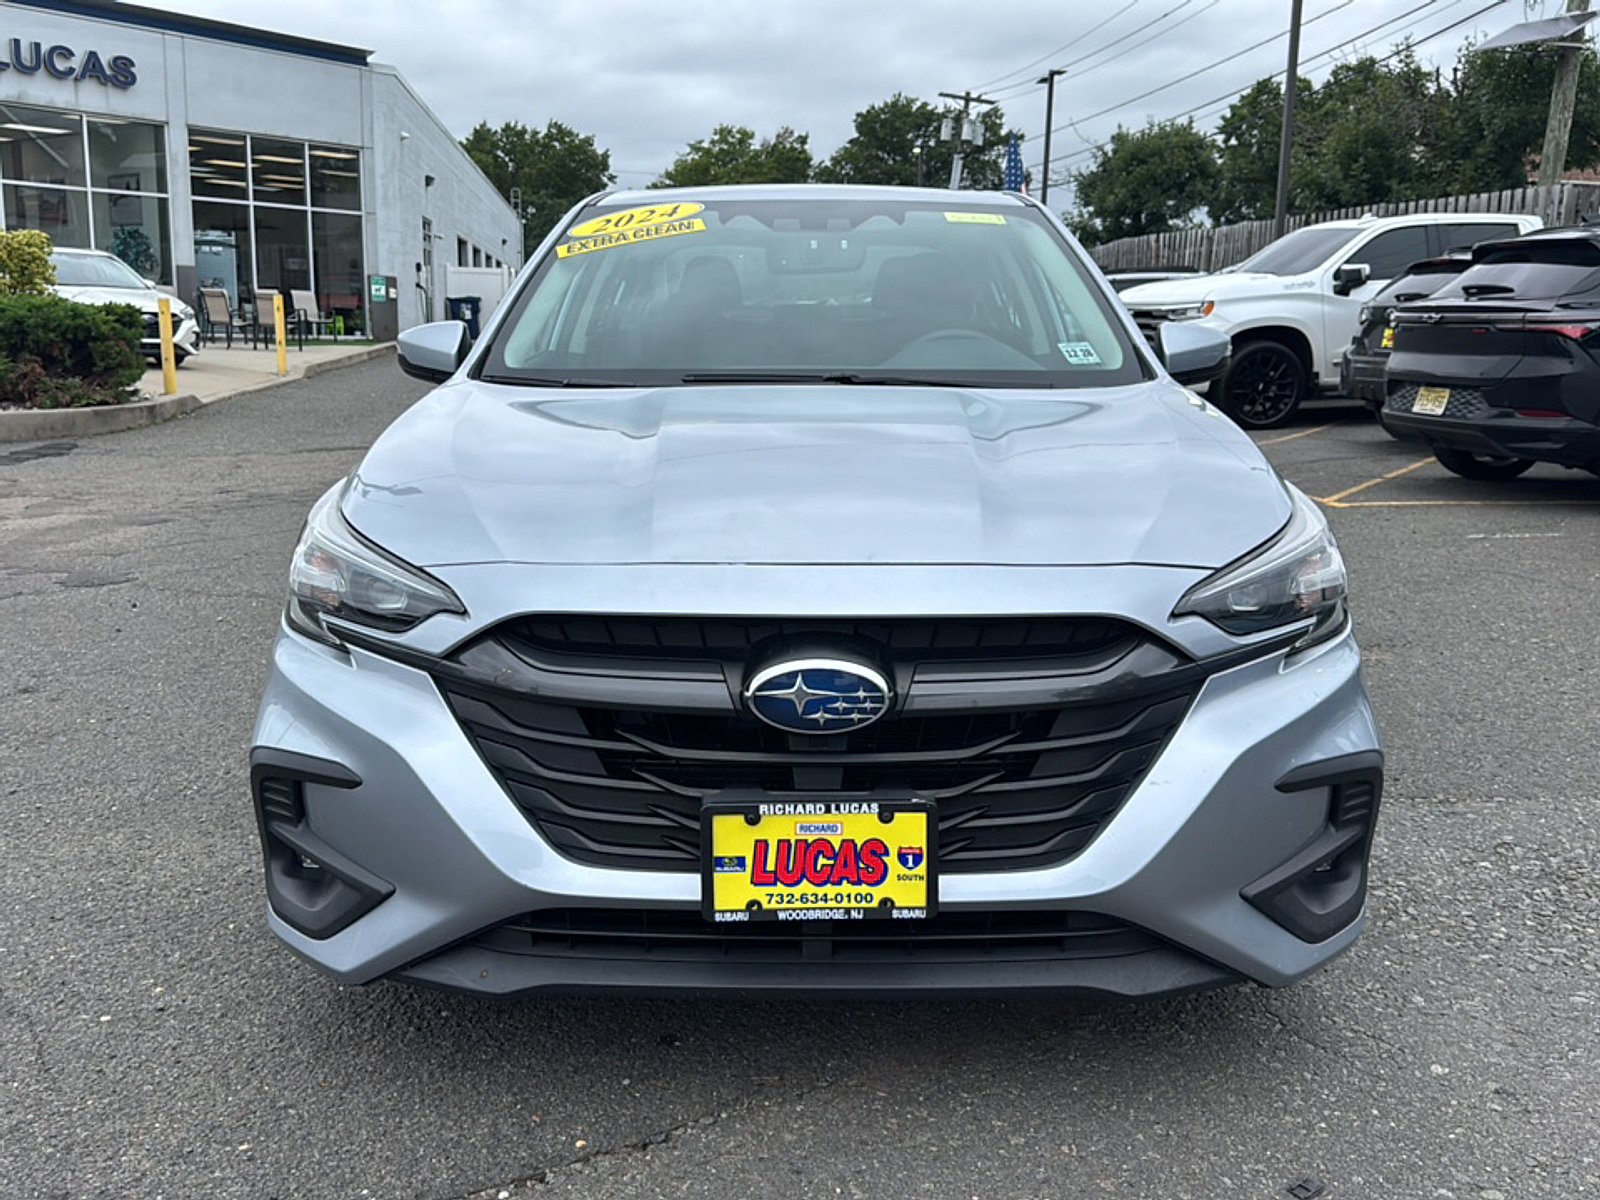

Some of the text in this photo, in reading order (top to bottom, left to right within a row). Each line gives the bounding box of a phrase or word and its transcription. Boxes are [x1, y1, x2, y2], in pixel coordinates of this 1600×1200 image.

[0, 38, 138, 89] UCAS
[592, 204, 682, 233] 2024
[566, 233, 630, 254] EXTRA
[759, 803, 880, 815] RICHARD LUCAS
[799, 824, 838, 833] RICHARD
[751, 838, 890, 887] LUCAS
[905, 854, 915, 868] 1
[765, 893, 875, 905] 732-634-0100
[714, 912, 750, 922] SUBARU
[850, 909, 864, 919] NJ
[891, 909, 926, 918] SUBARU
